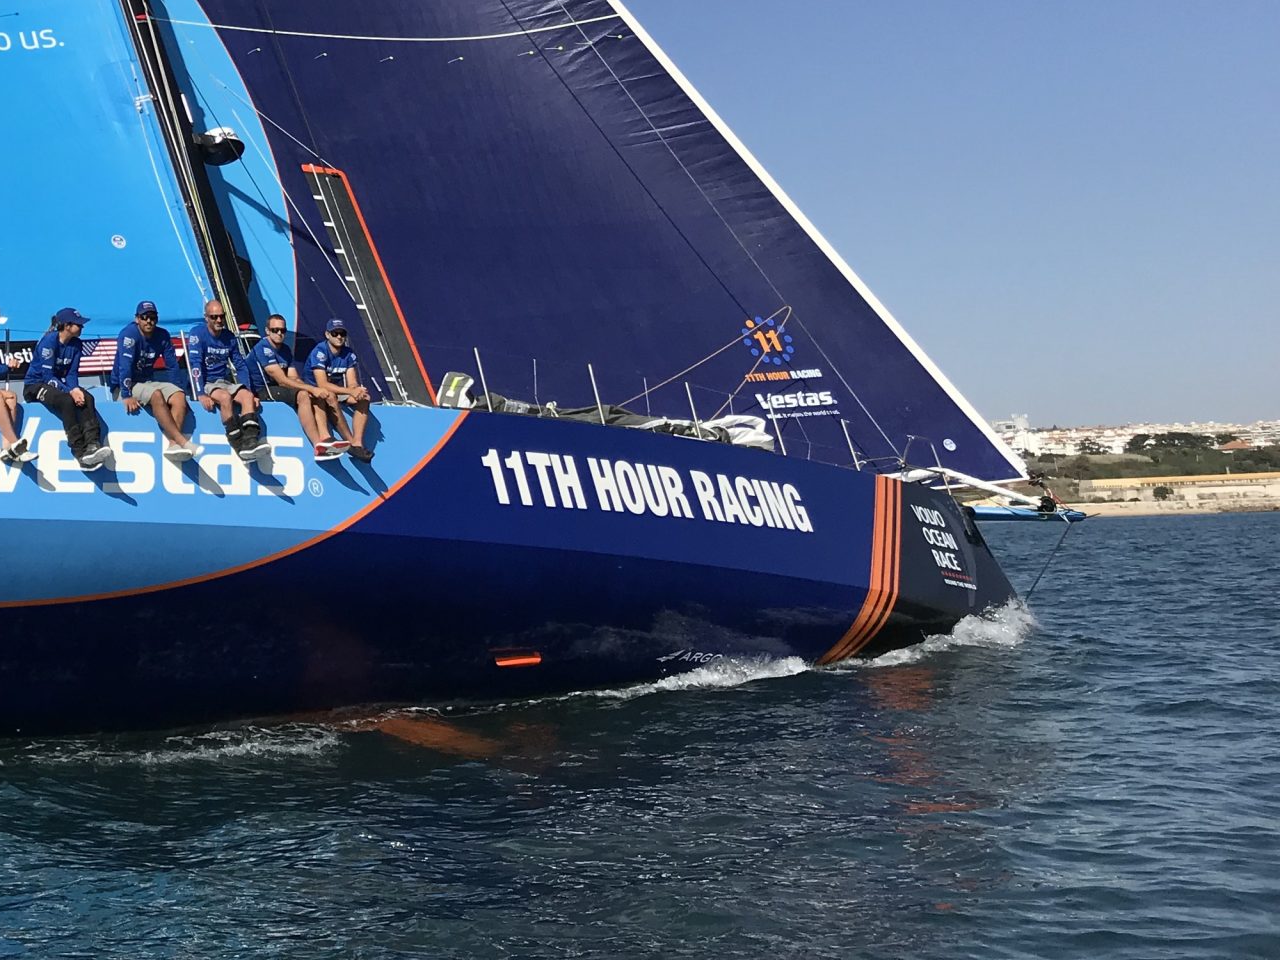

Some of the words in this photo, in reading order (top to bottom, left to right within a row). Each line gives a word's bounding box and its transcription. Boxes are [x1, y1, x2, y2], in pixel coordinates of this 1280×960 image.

[19, 27, 65, 51] us.
[753, 330, 782, 352] 11
[481, 448, 587, 511] 11TH
[587, 458, 692, 519] HOUR
[691, 470, 814, 533] RACING
[910, 504, 946, 528] VOLVO
[922, 527, 959, 550] OCEAN
[931, 549, 962, 571] RACE
